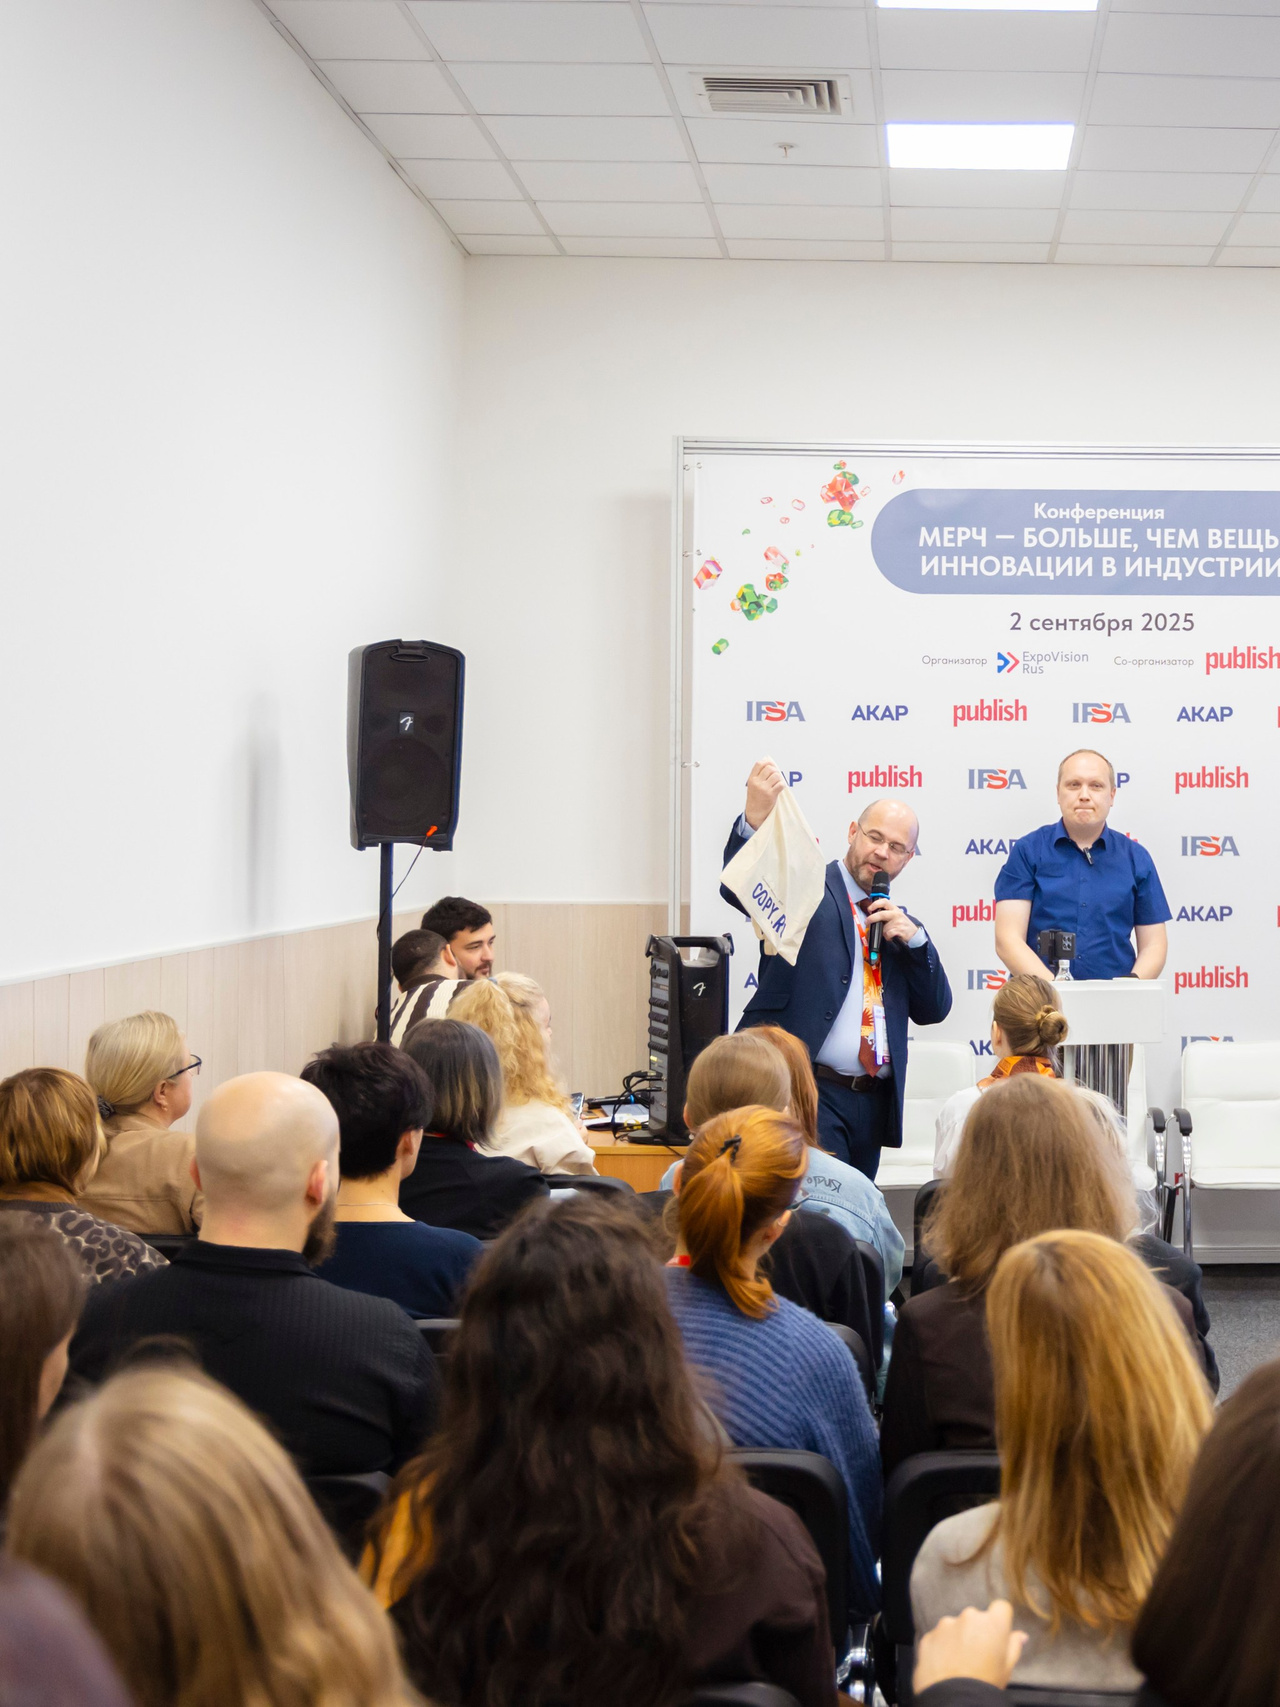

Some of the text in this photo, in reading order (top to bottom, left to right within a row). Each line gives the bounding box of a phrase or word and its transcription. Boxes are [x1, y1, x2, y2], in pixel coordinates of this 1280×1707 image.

[1034, 502, 1165, 525] Конференция
[918, 526, 987, 548] МЕРЧ
[1023, 526, 1139, 553] БОЛЬШЕ,
[1146, 527, 1200, 549] ЧЕМ
[921, 555, 1093, 581] ИННОВАЦИИ
[1102, 556, 1117, 577] В
[1009, 611, 1195, 638] 2 сентября 2025
[921, 654, 988, 668] Организатор
[1022, 650, 1089, 666] ExpoVision
[1022, 661, 1045, 675] Rus
[1113, 655, 1195, 668] Со-организатор
[953, 698, 1028, 728] publish
[847, 764, 923, 794] publish
[1174, 765, 1249, 795] publish
[952, 898, 997, 928] publ
[1174, 965, 1249, 995] publish
